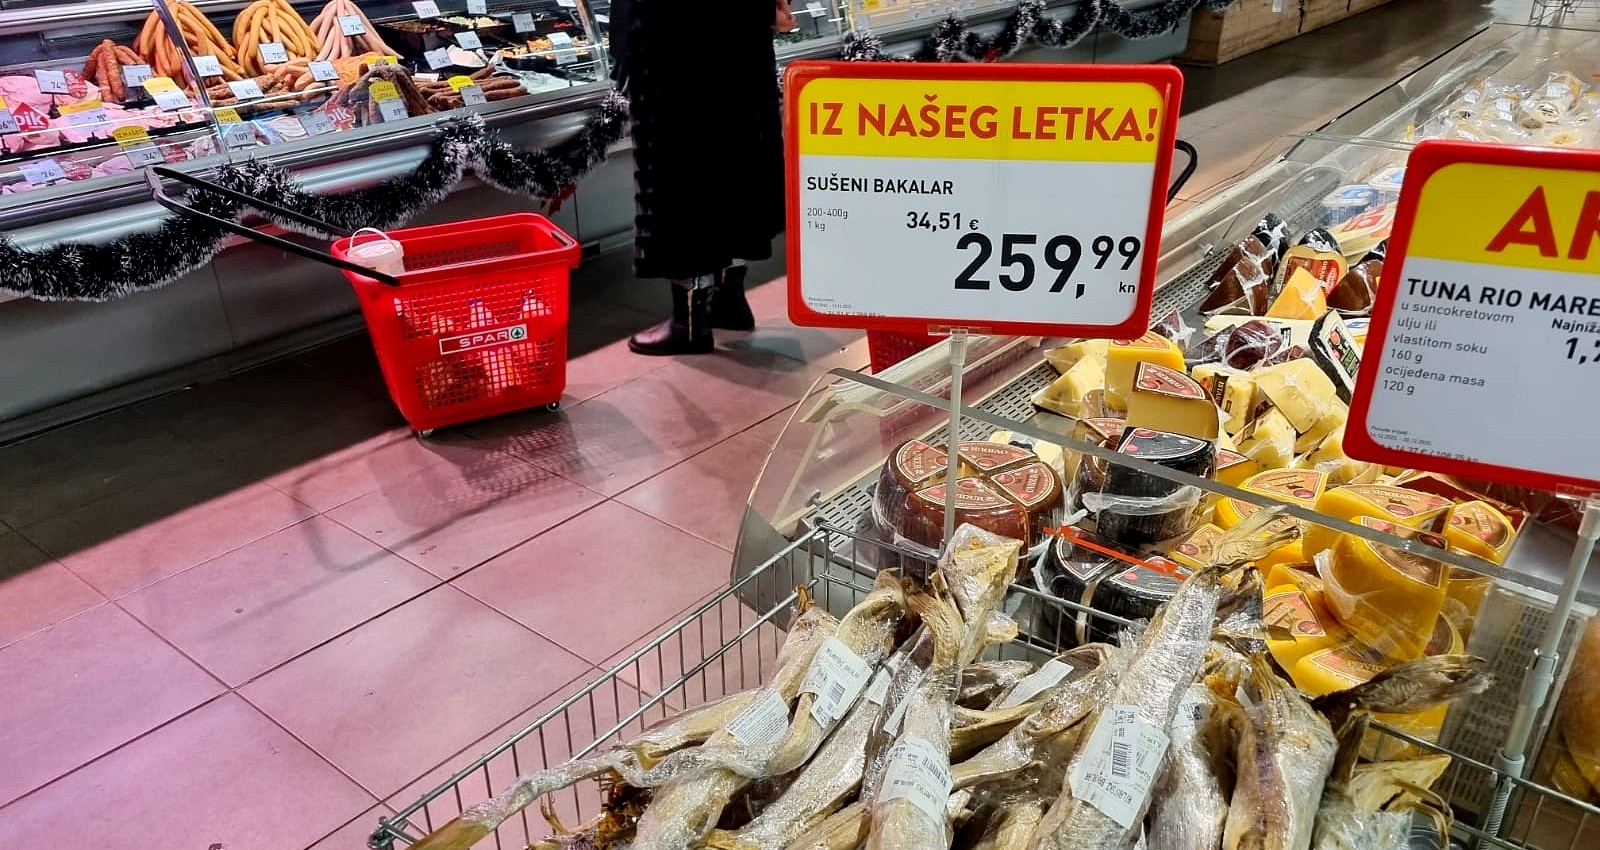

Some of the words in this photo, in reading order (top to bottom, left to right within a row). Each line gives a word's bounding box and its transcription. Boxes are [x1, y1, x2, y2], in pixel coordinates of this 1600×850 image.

[809, 102, 844, 136] IZ
[858, 94, 998, 139] NAŠEG
[1011, 106, 1160, 142] LETKA!
[806, 173, 869, 193] SUŠENI
[873, 178, 954, 196] BAKALAR
[807, 206, 849, 220] 200-400g
[906, 211, 962, 232] 34,51
[968, 219, 980, 231] €
[814, 221, 826, 232] kg
[1118, 282, 1137, 294] kn
[1407, 278, 1472, 302] TUNA
[1479, 287, 1523, 307] RIO
[1528, 292, 1600, 317] MARE
[1401, 302, 1410, 311] u
[1412, 302, 1515, 324] suncokretovom
[1397, 317, 1422, 331] ulju
[1424, 319, 1438, 331] ili
[459, 331, 509, 348] SPAR
[1392, 334, 1453, 350] vlastitom
[1455, 342, 1489, 355] soku
[1391, 348, 1413, 361] 160
[1414, 353, 1423, 365] g
[1383, 380, 1405, 392] 120
[1406, 385, 1416, 396] g
[1448, 374, 1486, 388] masa
